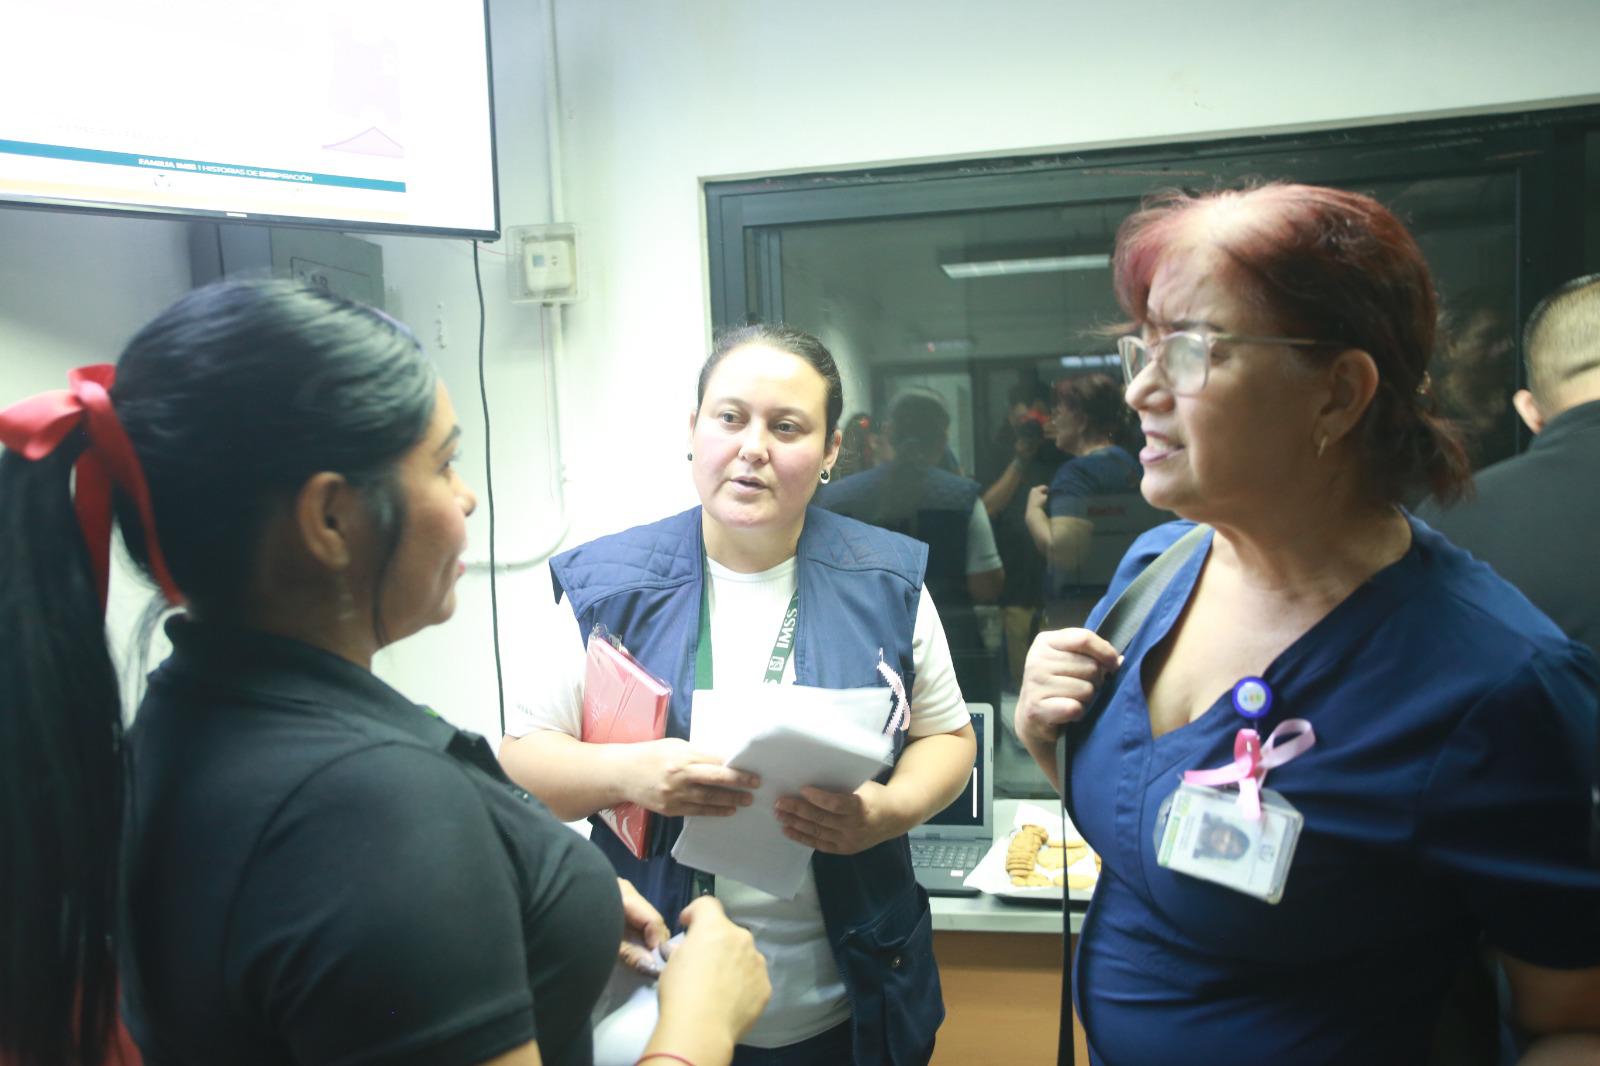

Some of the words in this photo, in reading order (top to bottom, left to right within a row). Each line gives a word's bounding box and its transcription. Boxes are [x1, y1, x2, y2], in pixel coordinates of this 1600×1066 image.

[138, 158, 175, 168] FAMILIA
[202, 164, 245, 176] HISTORIAS
[776, 608, 798, 649] IMSS
